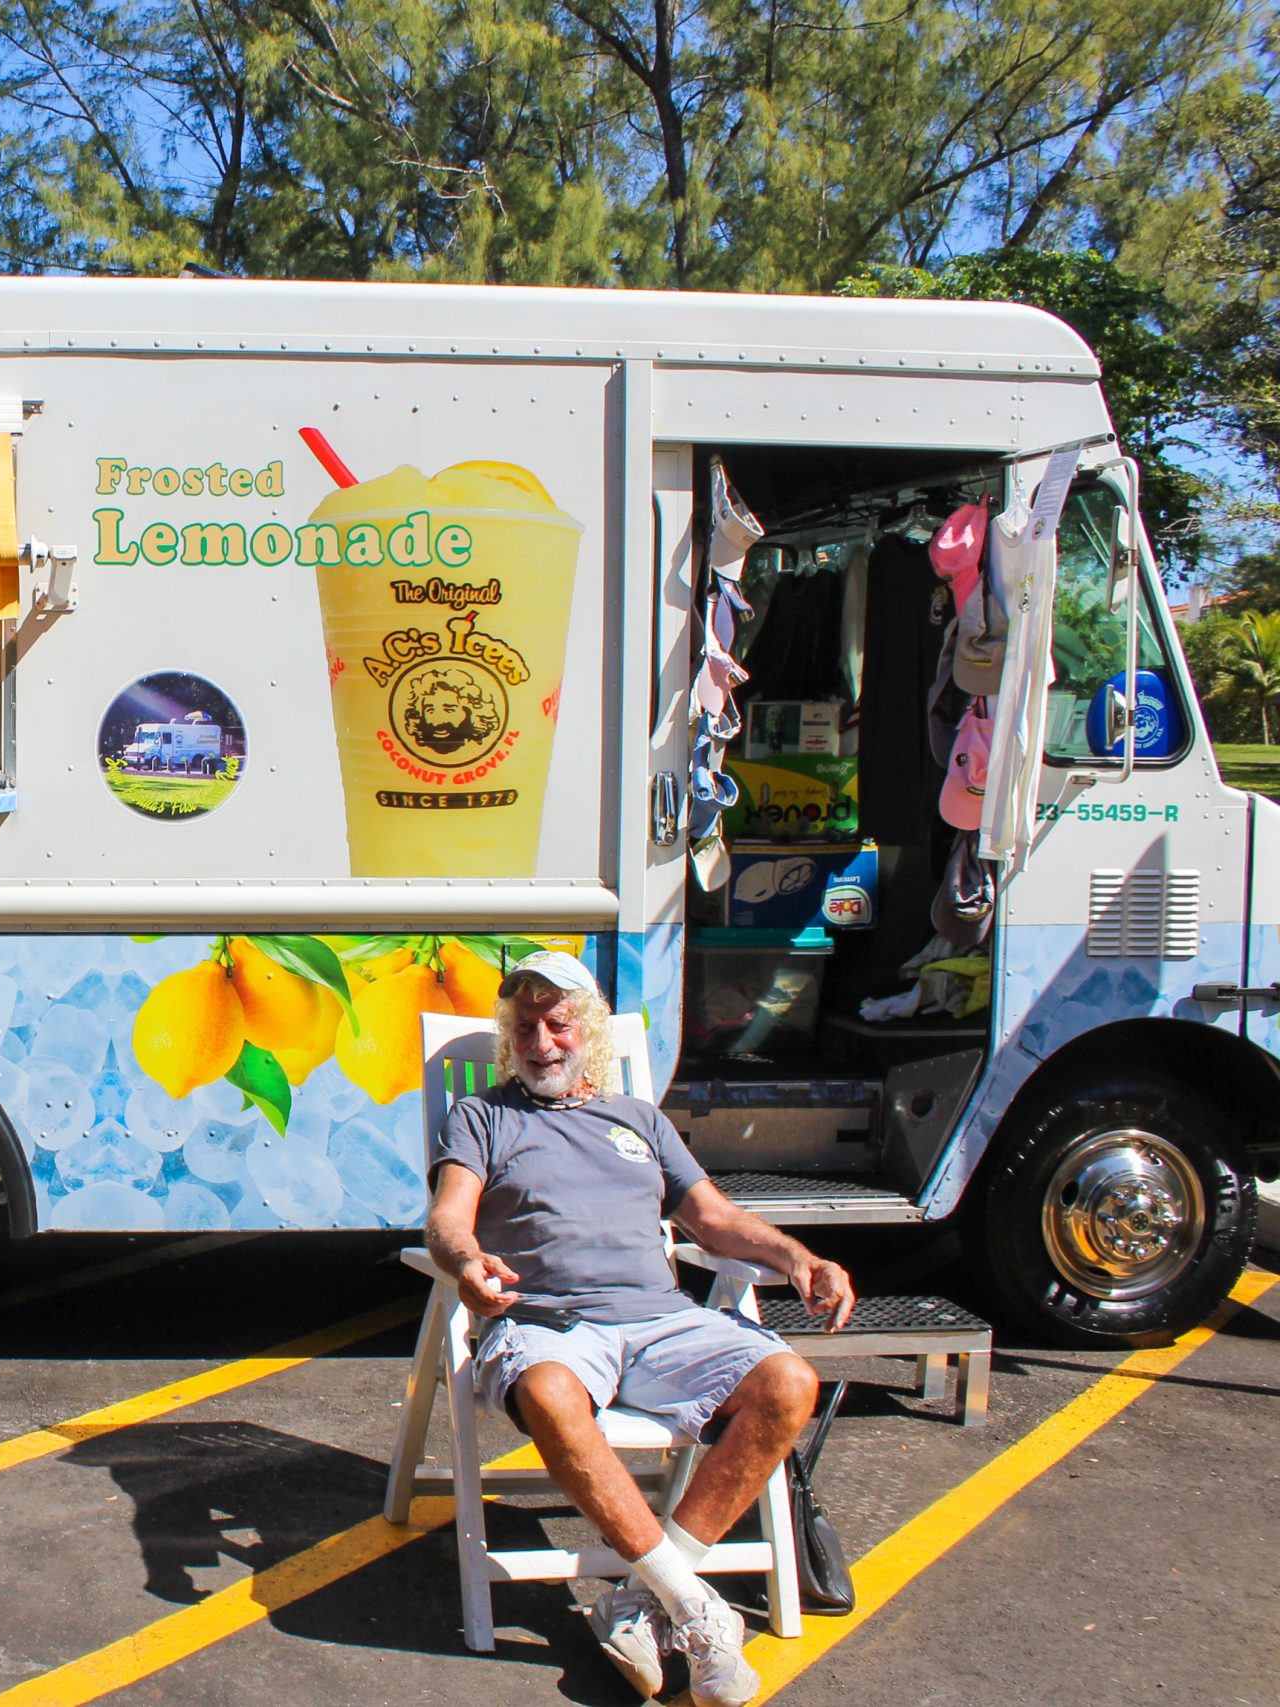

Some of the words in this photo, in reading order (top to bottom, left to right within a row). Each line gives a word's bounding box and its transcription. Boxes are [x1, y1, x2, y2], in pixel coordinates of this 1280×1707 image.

[95, 457, 284, 498] Frosted
[92, 507, 473, 568] Lemonade
[390, 579, 427, 604] The
[426, 576, 502, 611] Original
[446, 610, 530, 686] Icees
[376, 730, 447, 786] COCONUT
[504, 729, 520, 747] FL
[380, 792, 447, 808] SINCE
[467, 791, 516, 807] 1978
[833, 875, 861, 883] Lemons
[829, 899, 862, 917] Dole
